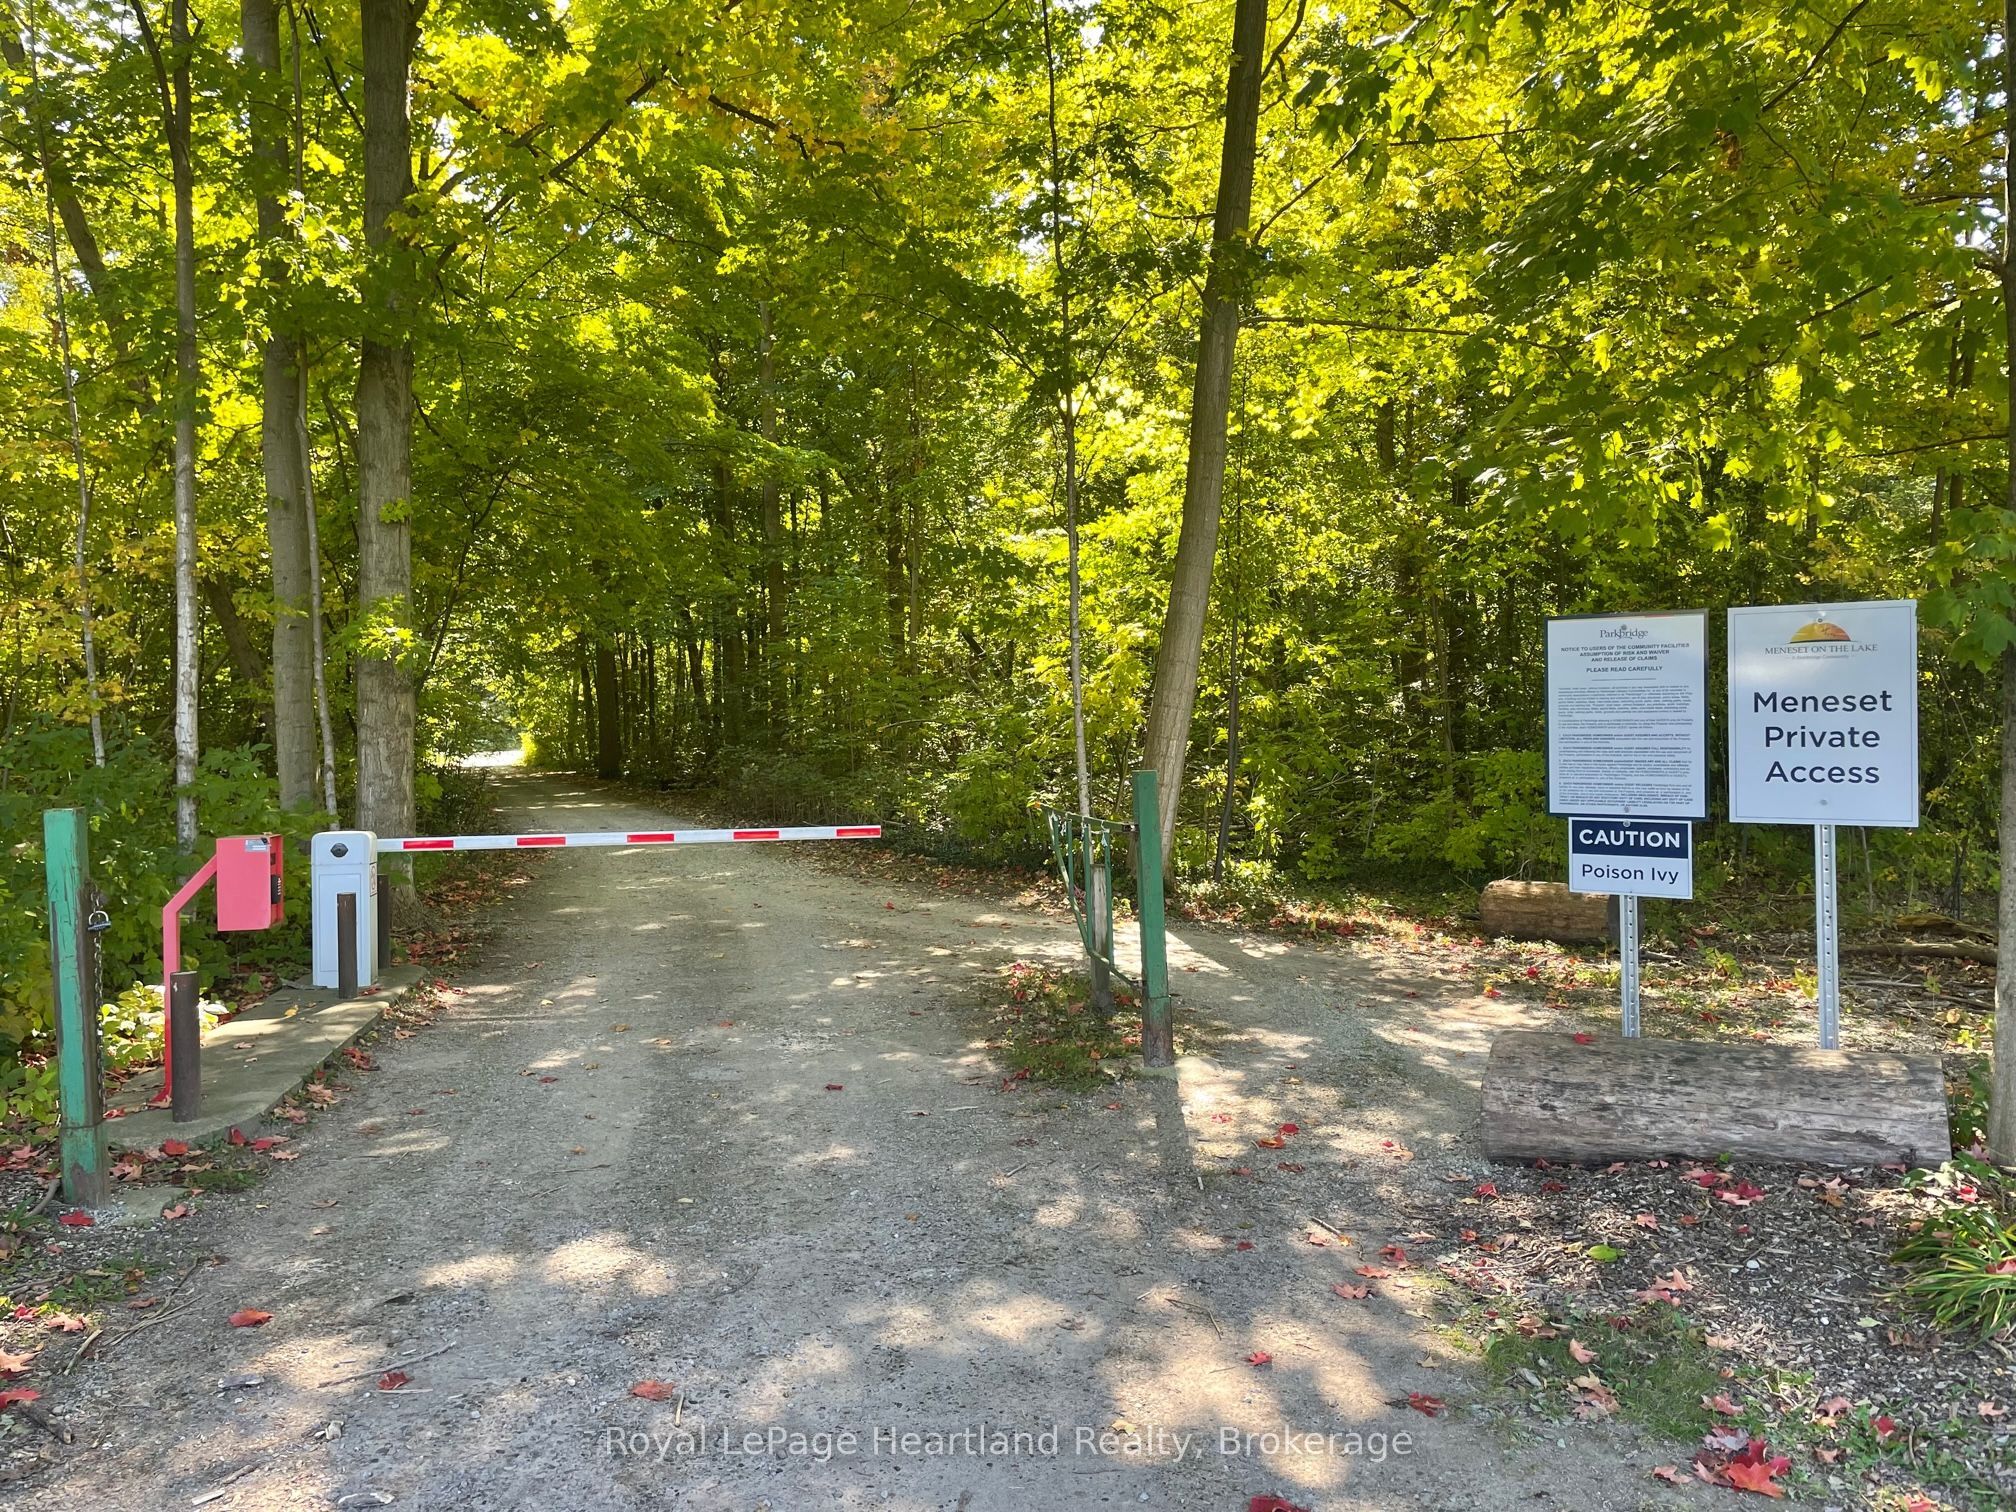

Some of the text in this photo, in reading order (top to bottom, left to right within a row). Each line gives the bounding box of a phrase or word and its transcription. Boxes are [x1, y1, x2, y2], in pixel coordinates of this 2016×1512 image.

[1600, 628, 1649, 639] Parkbridge
[1765, 643, 1878, 655] MENESET ON THE LAKE
[1753, 690, 1892, 713] Meneset
[1765, 725, 1880, 748] Private
[1765, 761, 1880, 783] Access
[1579, 829, 1680, 848] CAUTION
[1582, 864, 1679, 885] Poison Ivy
